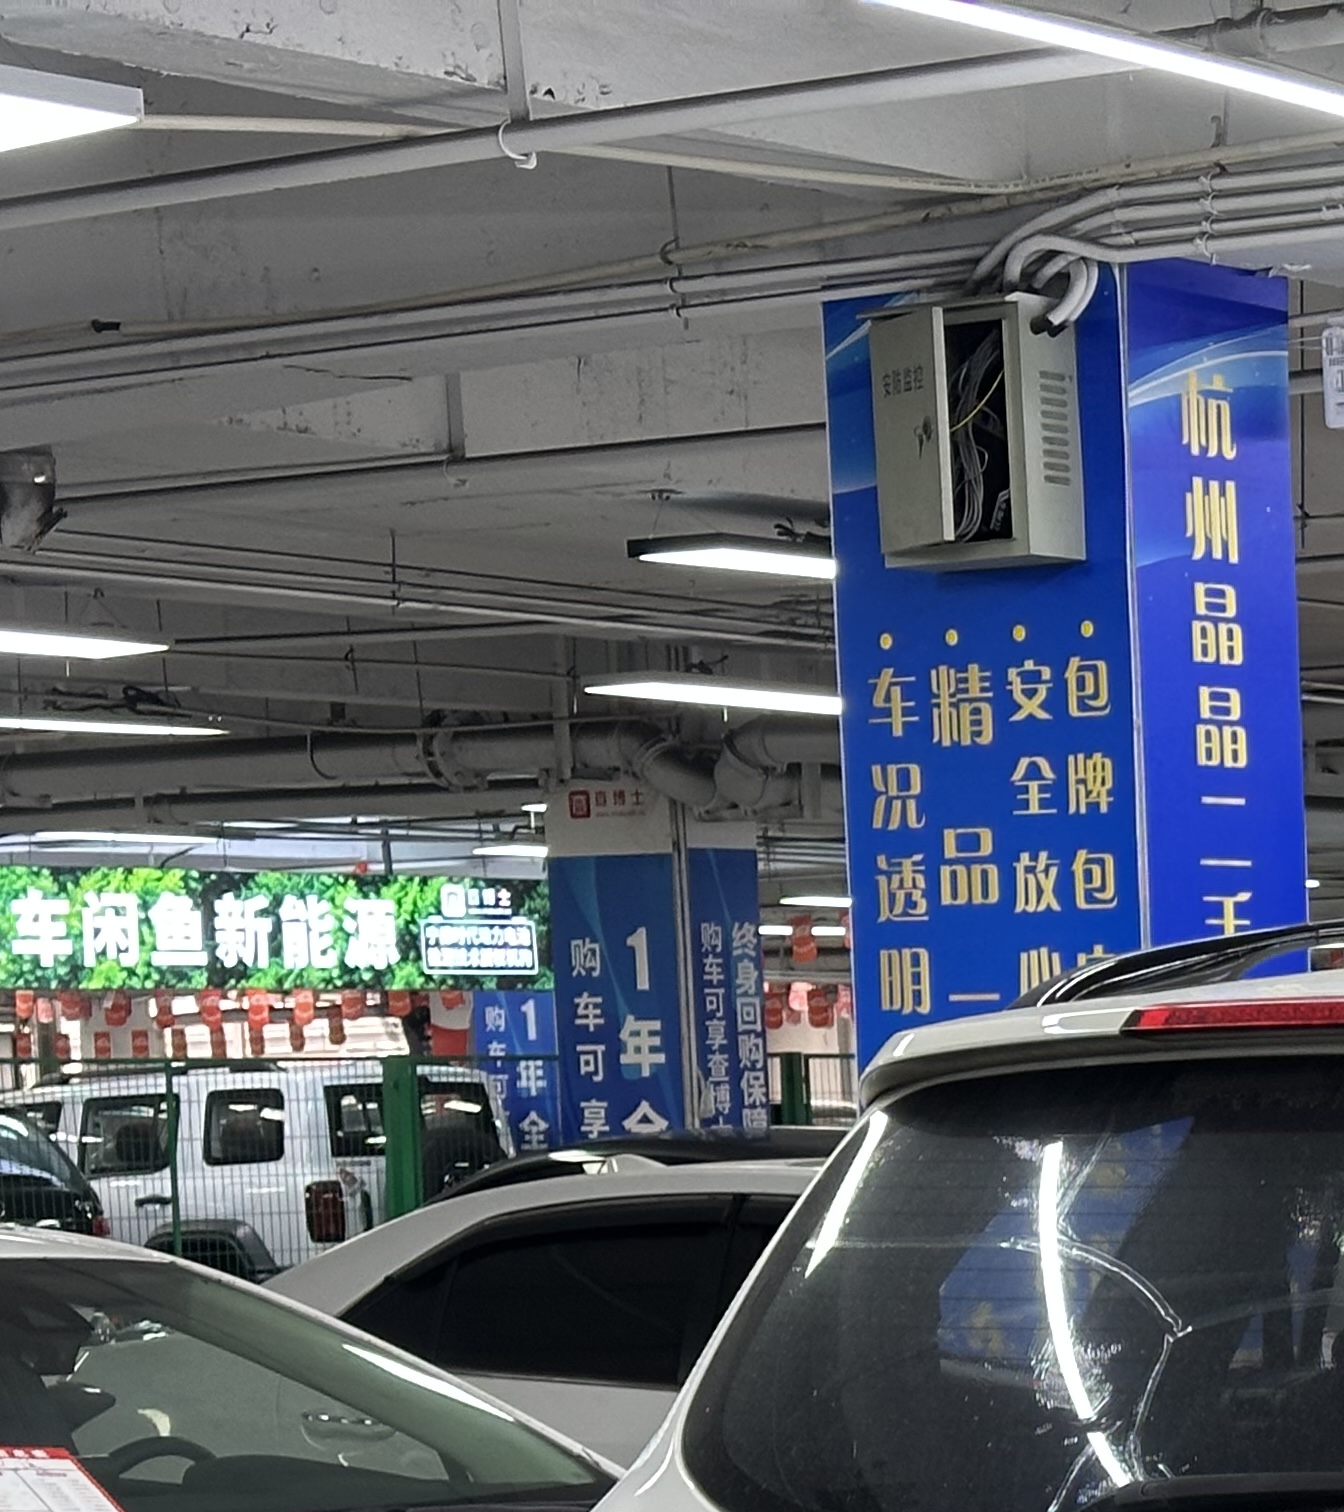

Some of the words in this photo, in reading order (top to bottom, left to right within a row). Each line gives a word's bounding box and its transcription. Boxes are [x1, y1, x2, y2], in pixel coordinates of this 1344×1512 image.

[11, 887, 401, 970] 车闲鱼新能源
[868, 667, 931, 1015] 车况透明
[570, 938, 610, 1140] 购车可享
